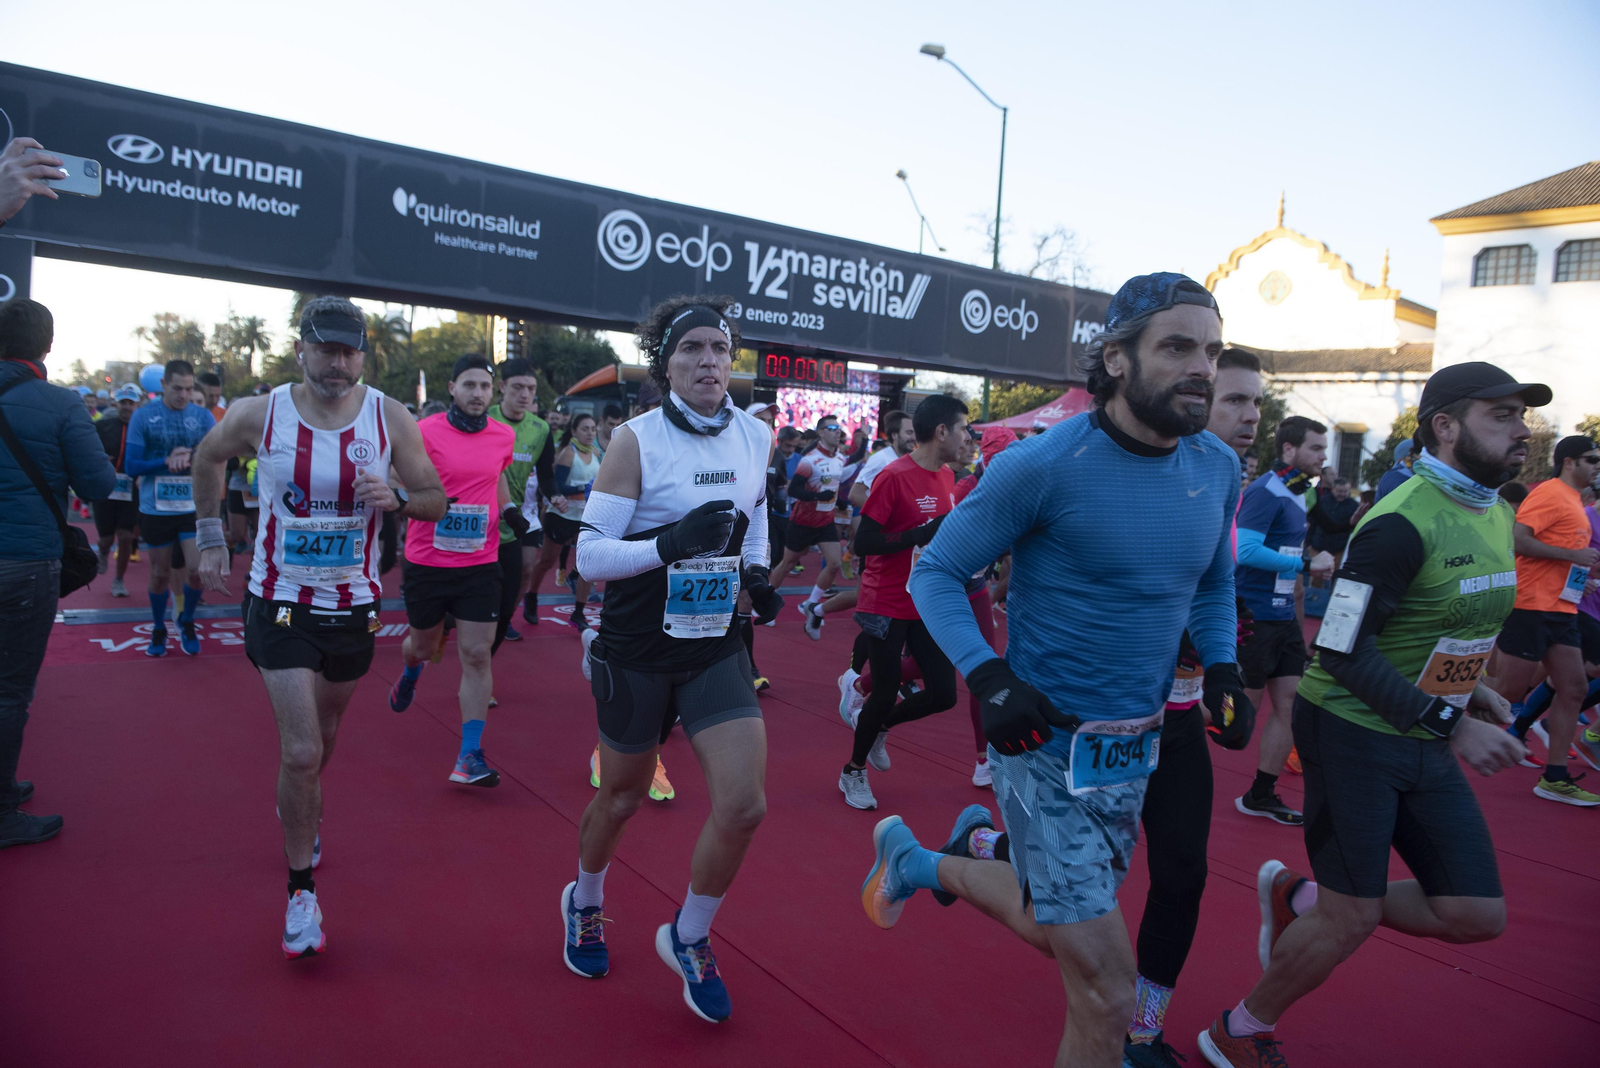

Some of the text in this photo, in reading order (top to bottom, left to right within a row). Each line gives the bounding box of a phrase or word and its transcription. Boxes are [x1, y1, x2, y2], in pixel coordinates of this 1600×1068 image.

[171, 146, 302, 188] HYUNDAI
[105, 168, 300, 217] Hyundauto Motor
[415, 203, 541, 239] quirónsalud
[435, 231, 539, 260] Healthcare Partner
[656, 224, 732, 282] edp
[782, 248, 904, 293] maratón
[813, 282, 906, 319] sevilla
[745, 307, 788, 325] enero
[791, 311, 824, 330] 2023
[993, 298, 1039, 340] edp
[694, 471, 734, 485] CARADURA
[163, 485, 189, 496] 2760
[300, 500, 365, 510] JAMENA
[445, 515, 479, 531] 2610
[296, 535, 347, 555] 2477
[1444, 554, 1475, 569] HOKA
[681, 578, 728, 602] 2723
[1460, 575, 1490, 594] MEDIO
[1436, 658, 1484, 683] 3852
